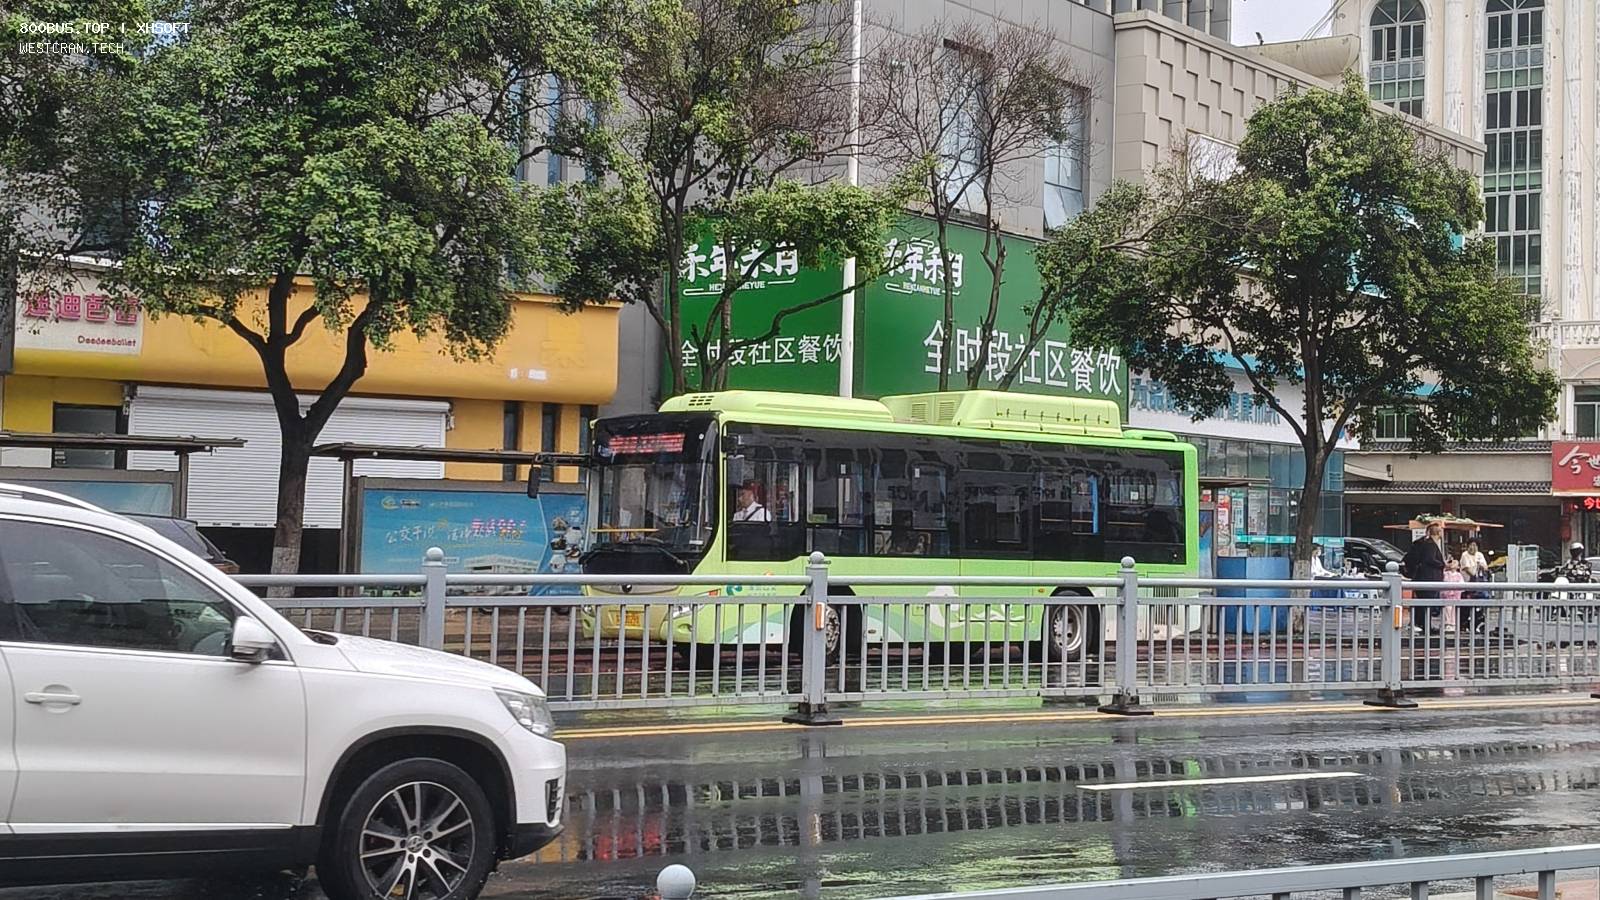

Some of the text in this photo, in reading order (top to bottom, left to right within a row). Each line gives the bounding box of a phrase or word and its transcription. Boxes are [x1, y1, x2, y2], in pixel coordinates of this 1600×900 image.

[923, 319, 1122, 396] 全时段社区餐饮
